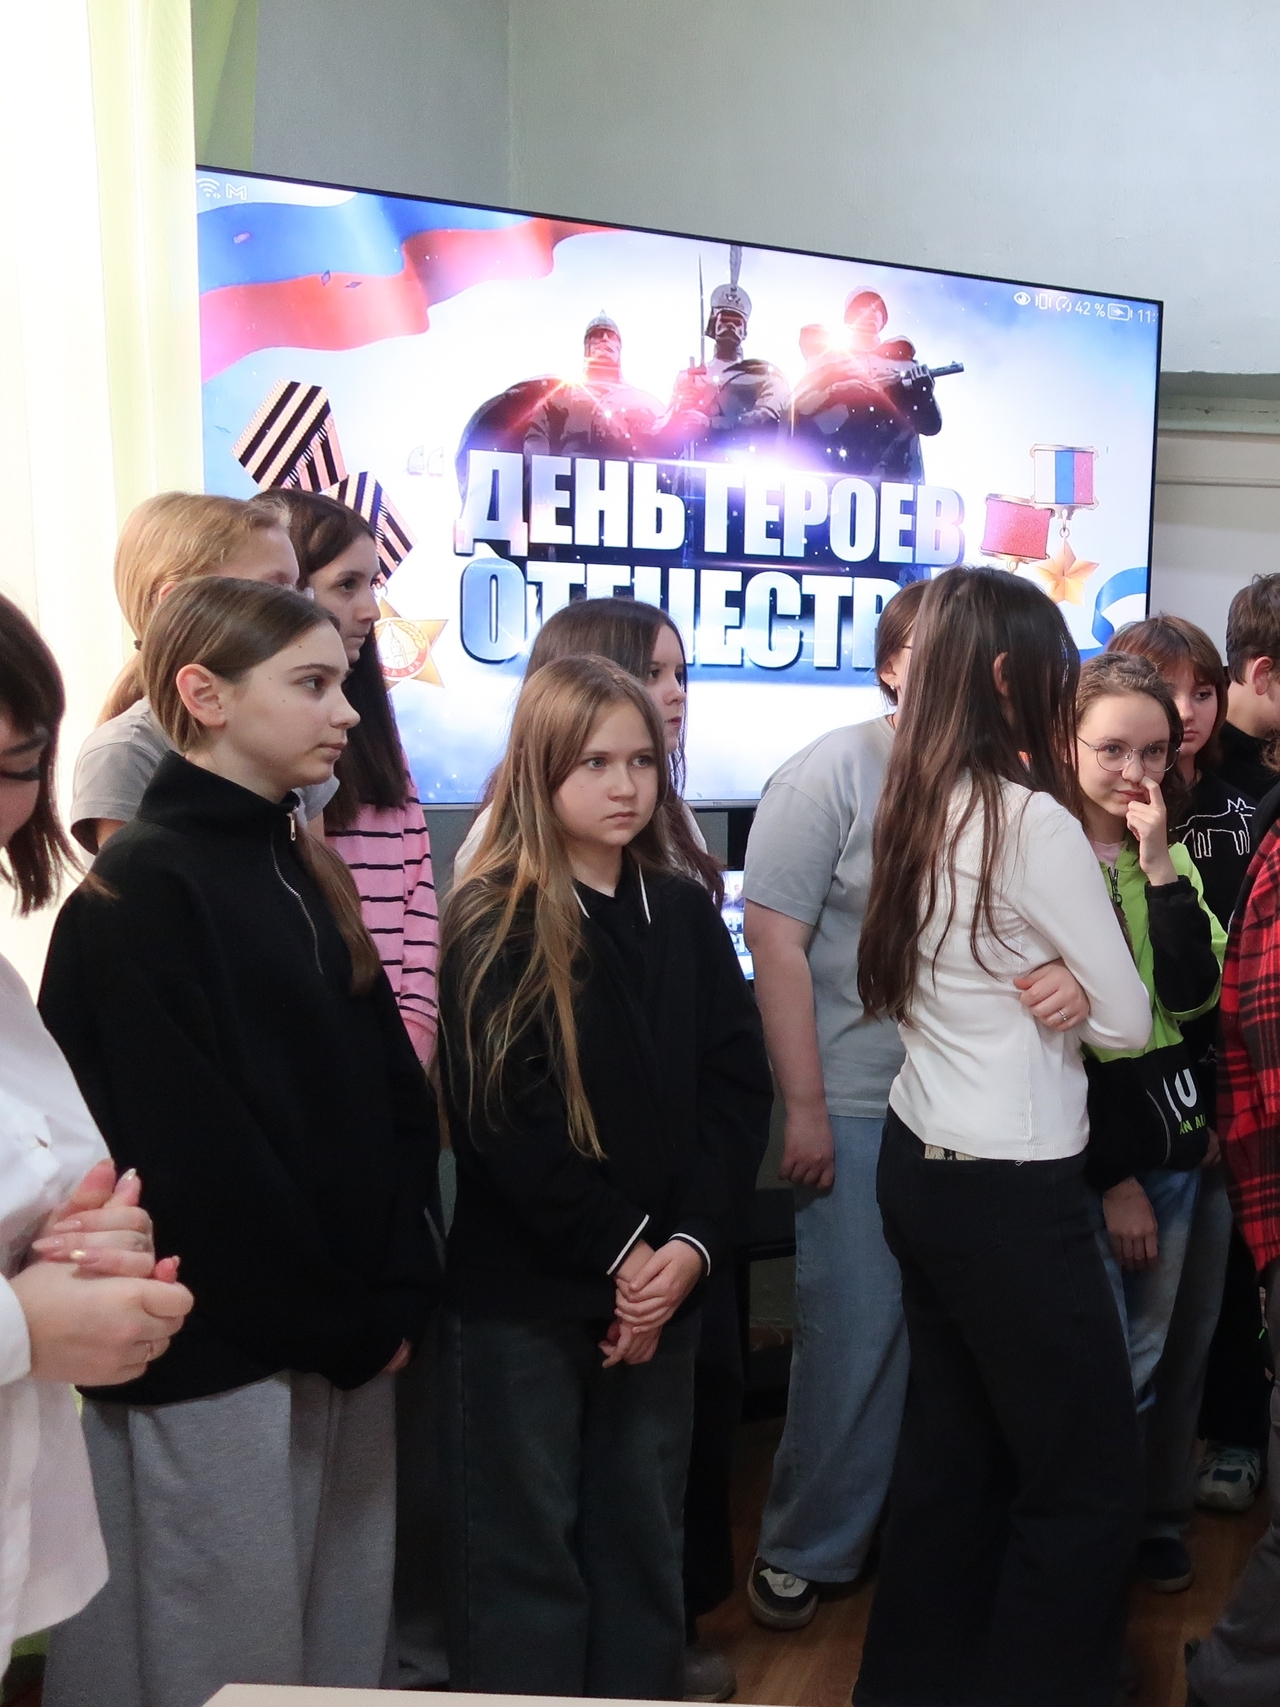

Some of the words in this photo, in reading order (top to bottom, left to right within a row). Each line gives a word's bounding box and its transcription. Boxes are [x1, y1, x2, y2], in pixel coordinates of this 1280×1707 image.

[1075, 301, 1091, 316] 42
[1137, 310, 1159, 324] 11:
[453, 448, 687, 557] ДЕНЬ
[702, 464, 965, 567] ГЕРОЕВ
[460, 555, 903, 672] ОТЧЕСТВ
